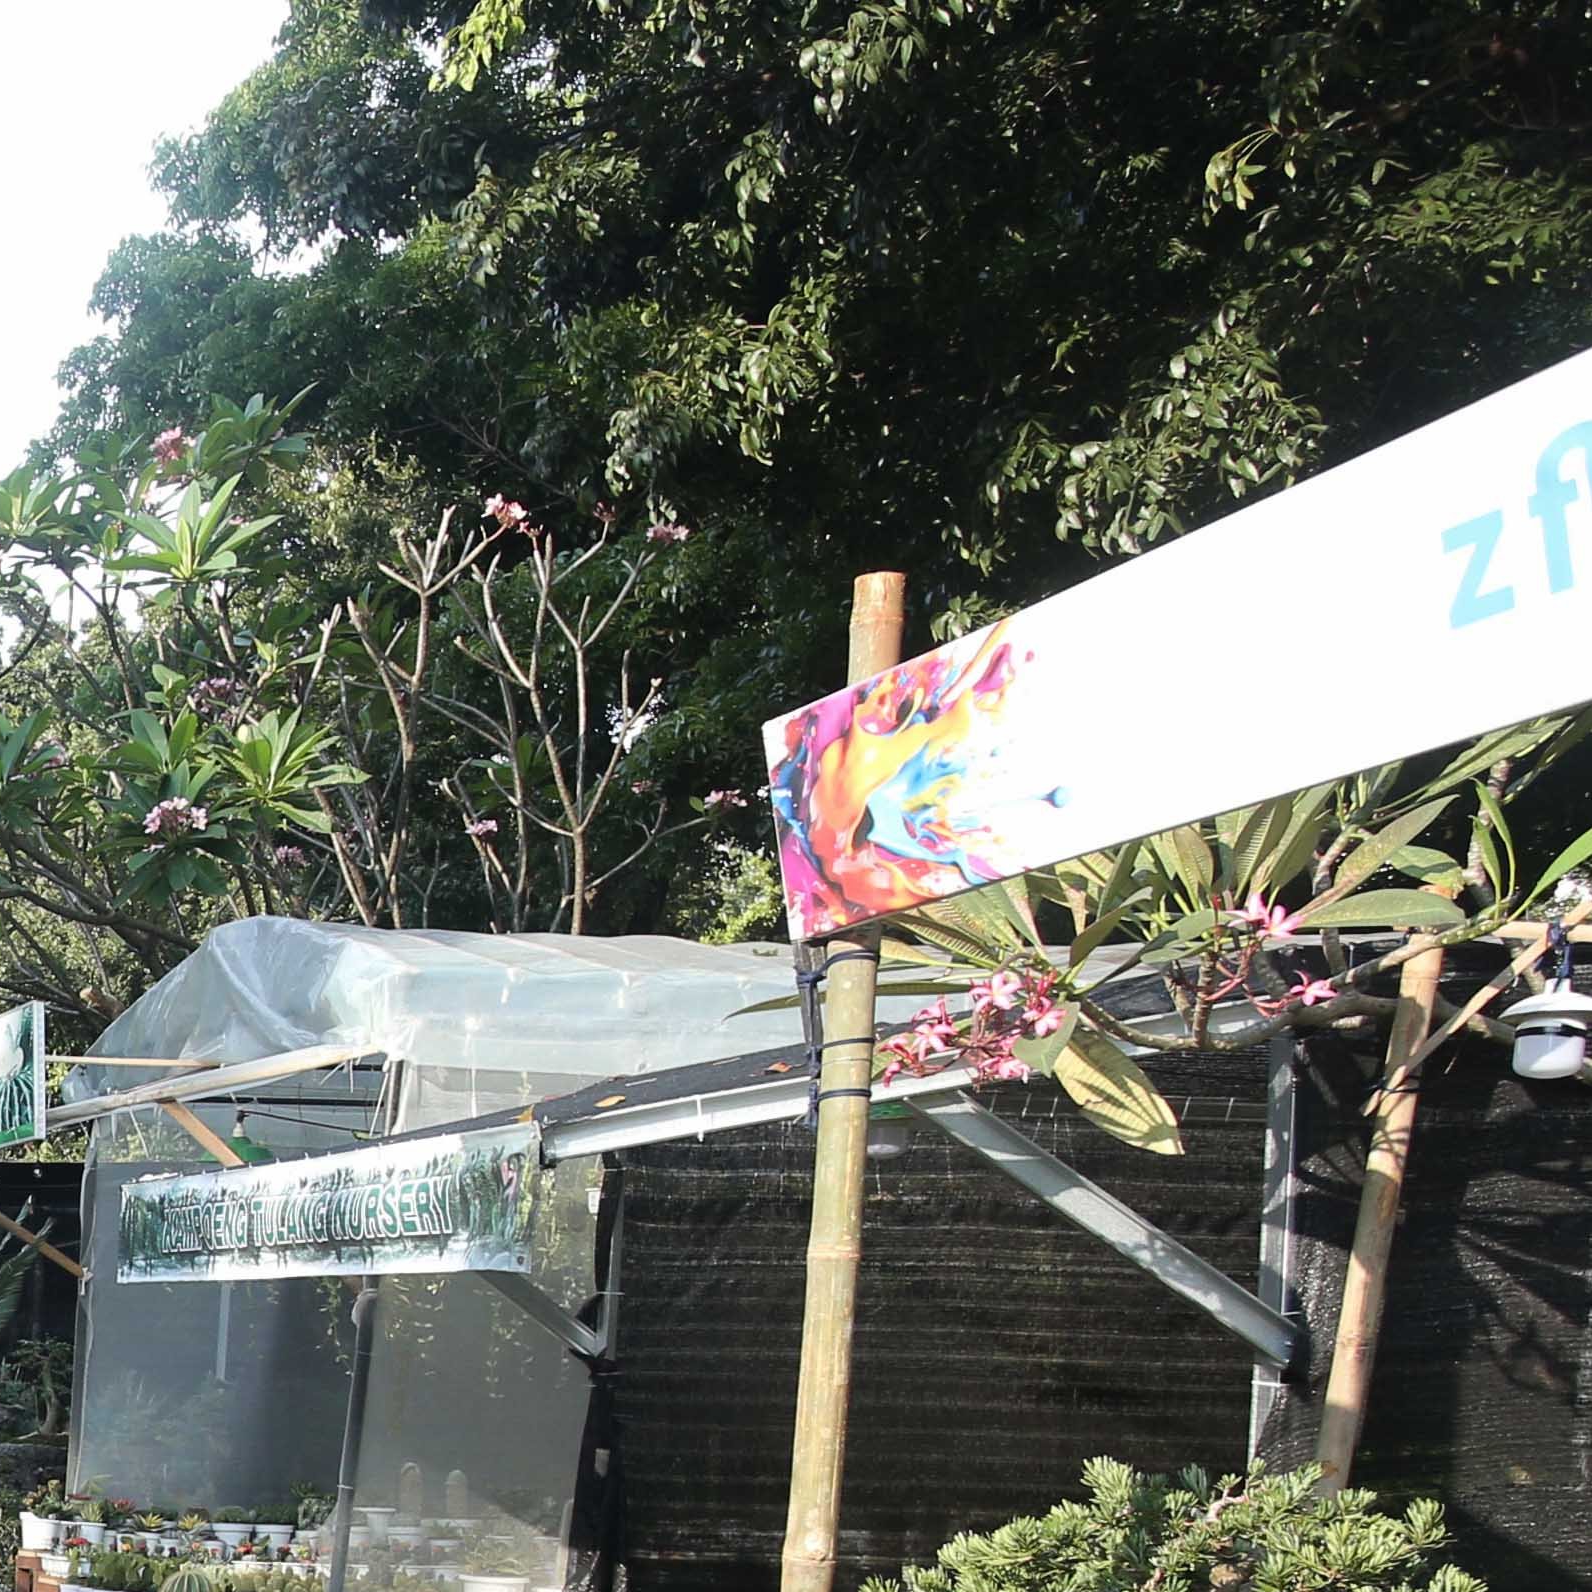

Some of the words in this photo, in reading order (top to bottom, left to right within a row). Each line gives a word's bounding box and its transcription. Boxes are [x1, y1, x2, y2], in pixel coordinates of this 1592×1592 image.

[162, 1201, 247, 1254] KAMPOENG
[251, 1191, 329, 1247] TULANG
[331, 1176, 454, 1241] NURSERY
